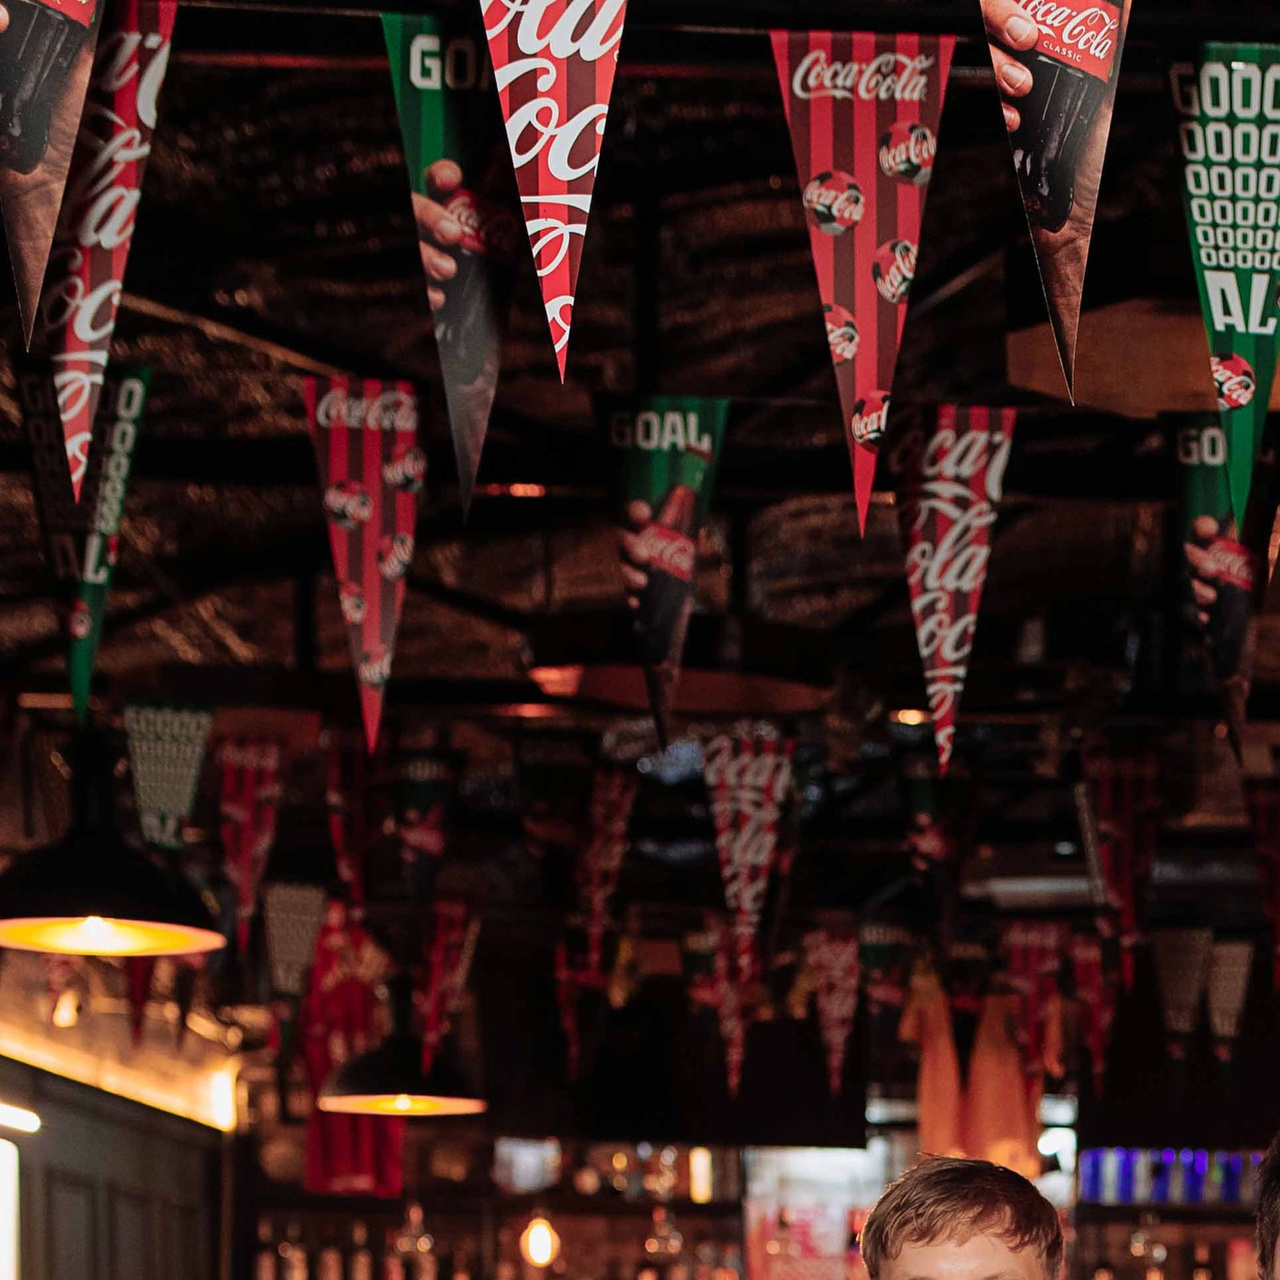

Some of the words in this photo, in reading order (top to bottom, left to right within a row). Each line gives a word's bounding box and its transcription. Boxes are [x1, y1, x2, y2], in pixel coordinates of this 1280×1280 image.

[1018, 0, 1119, 60] oca-Cola
[1043, 40, 1083, 63] CLASSIC
[792, 50, 935, 101] Coca-Cola
[1203, 270, 1278, 335] AL
